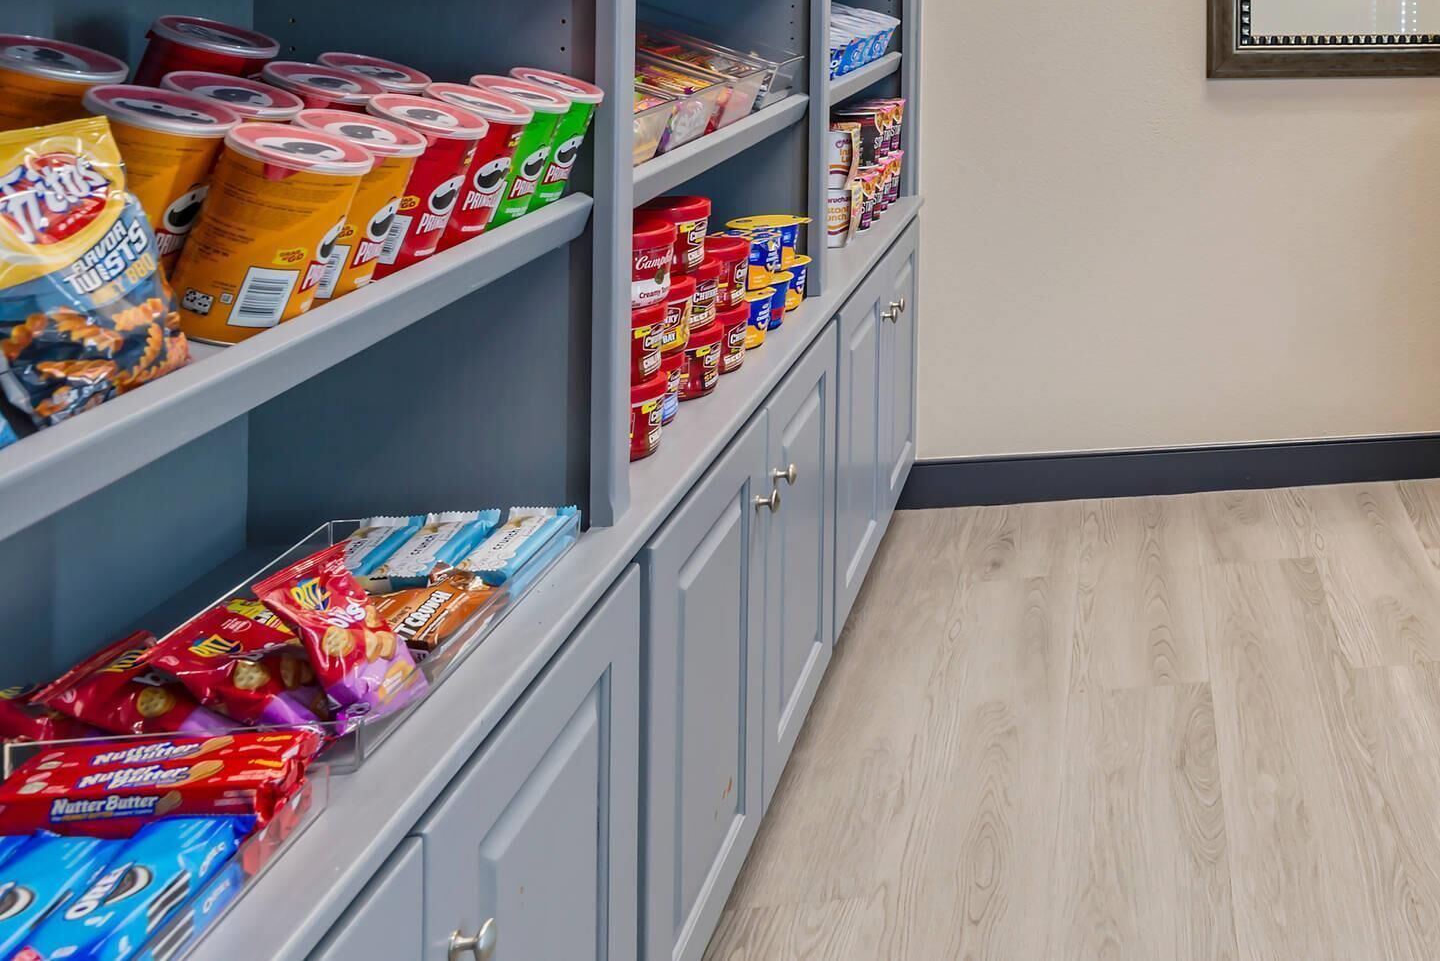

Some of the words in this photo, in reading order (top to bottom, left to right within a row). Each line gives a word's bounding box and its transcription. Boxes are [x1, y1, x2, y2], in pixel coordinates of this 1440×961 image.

[63, 219, 150, 296] TWISTS
[71, 218, 129, 276] FLAVOR
[291, 577, 331, 611] RITZ
[403, 590, 453, 627] CRUNCH
[188, 634, 241, 658] RITZ
[92, 742, 171, 767] Nutter
[123, 743, 201, 765] Butter
[77, 765, 160, 789] Nutter
[106, 766, 190, 790] Butter
[50, 794, 106, 815] Nutter
[106, 794, 159, 813] Butter
